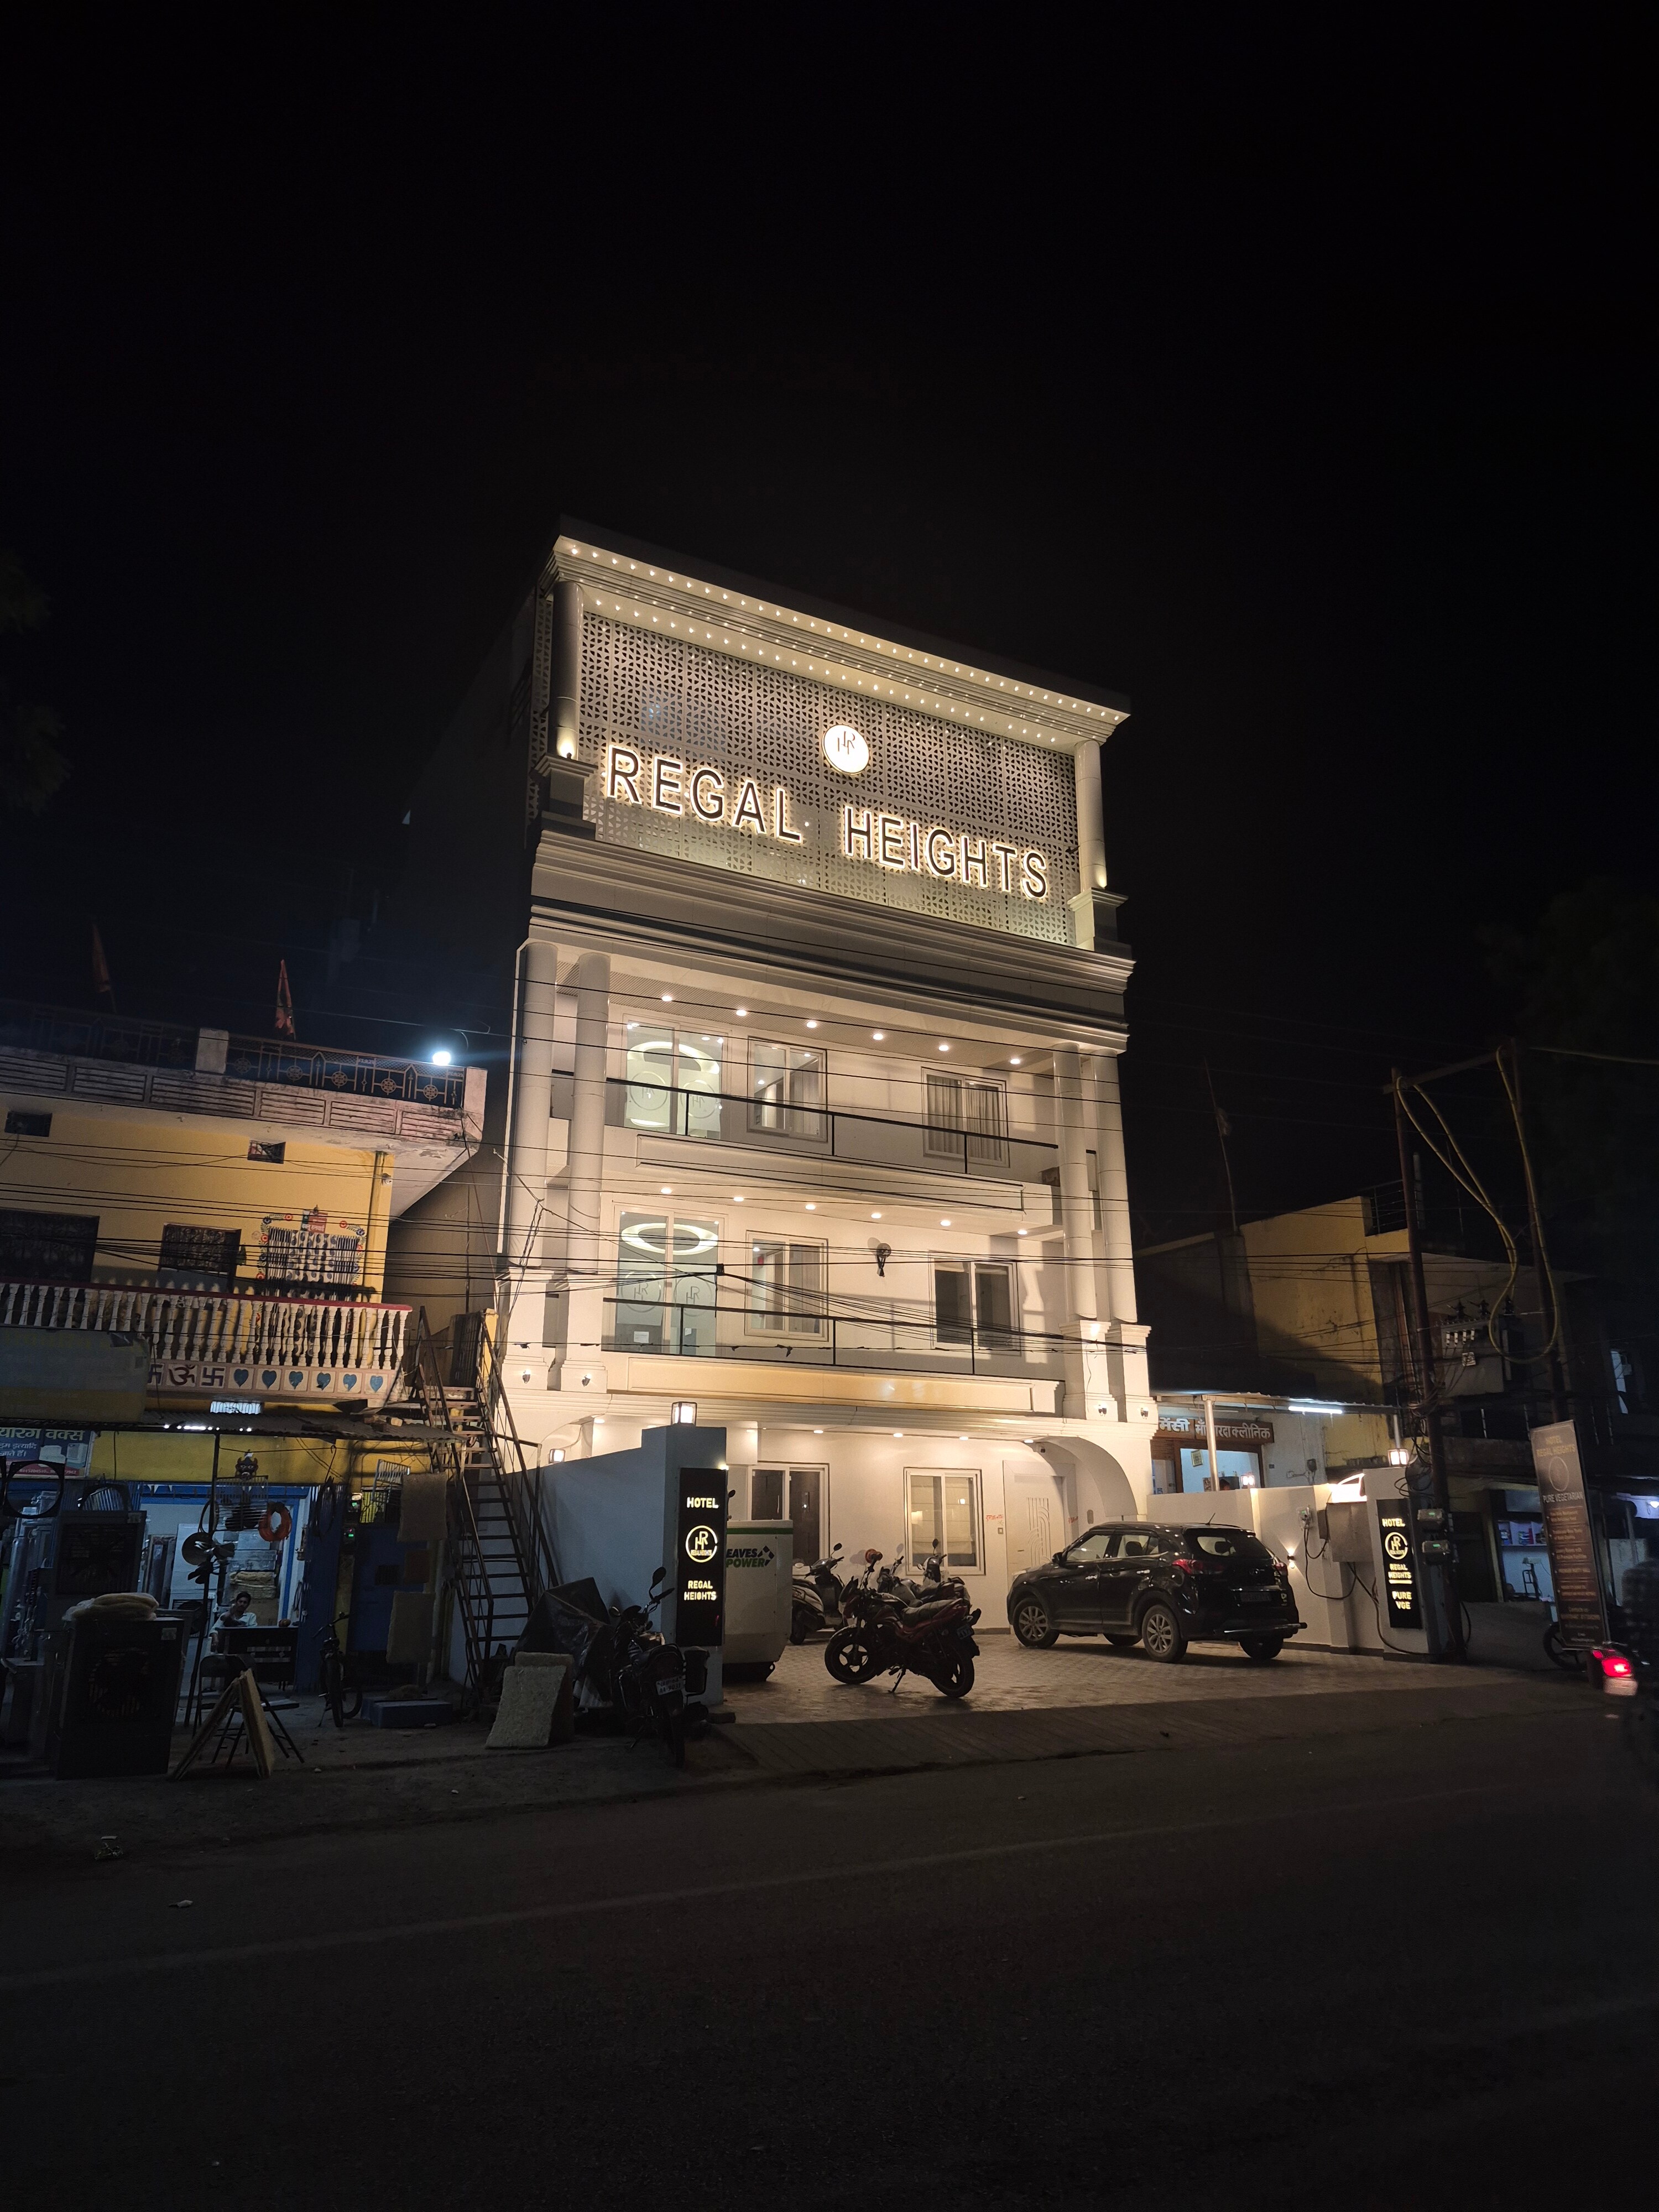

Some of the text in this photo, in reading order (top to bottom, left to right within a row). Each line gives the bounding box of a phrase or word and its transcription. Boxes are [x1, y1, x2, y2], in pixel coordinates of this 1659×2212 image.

[607, 744, 1047, 899] REGAL HEIGHTS
[1542, 1491, 1584, 1504] PURE VEGETARIAN
[686, 1497, 719, 1509] HOTEL
[1382, 1518, 1405, 1528] HOTEL
[726, 1548, 758, 1558] EAVES
[726, 1558, 765, 1568] POWER
[1387, 1571, 1412, 1579] HEIGHTS
[687, 1580, 713, 1589] REGAL
[684, 1592, 717, 1601] HEIGHTS
[1391, 1590, 1412, 1600] PURE
[1395, 1601, 1411, 1610] VGE
